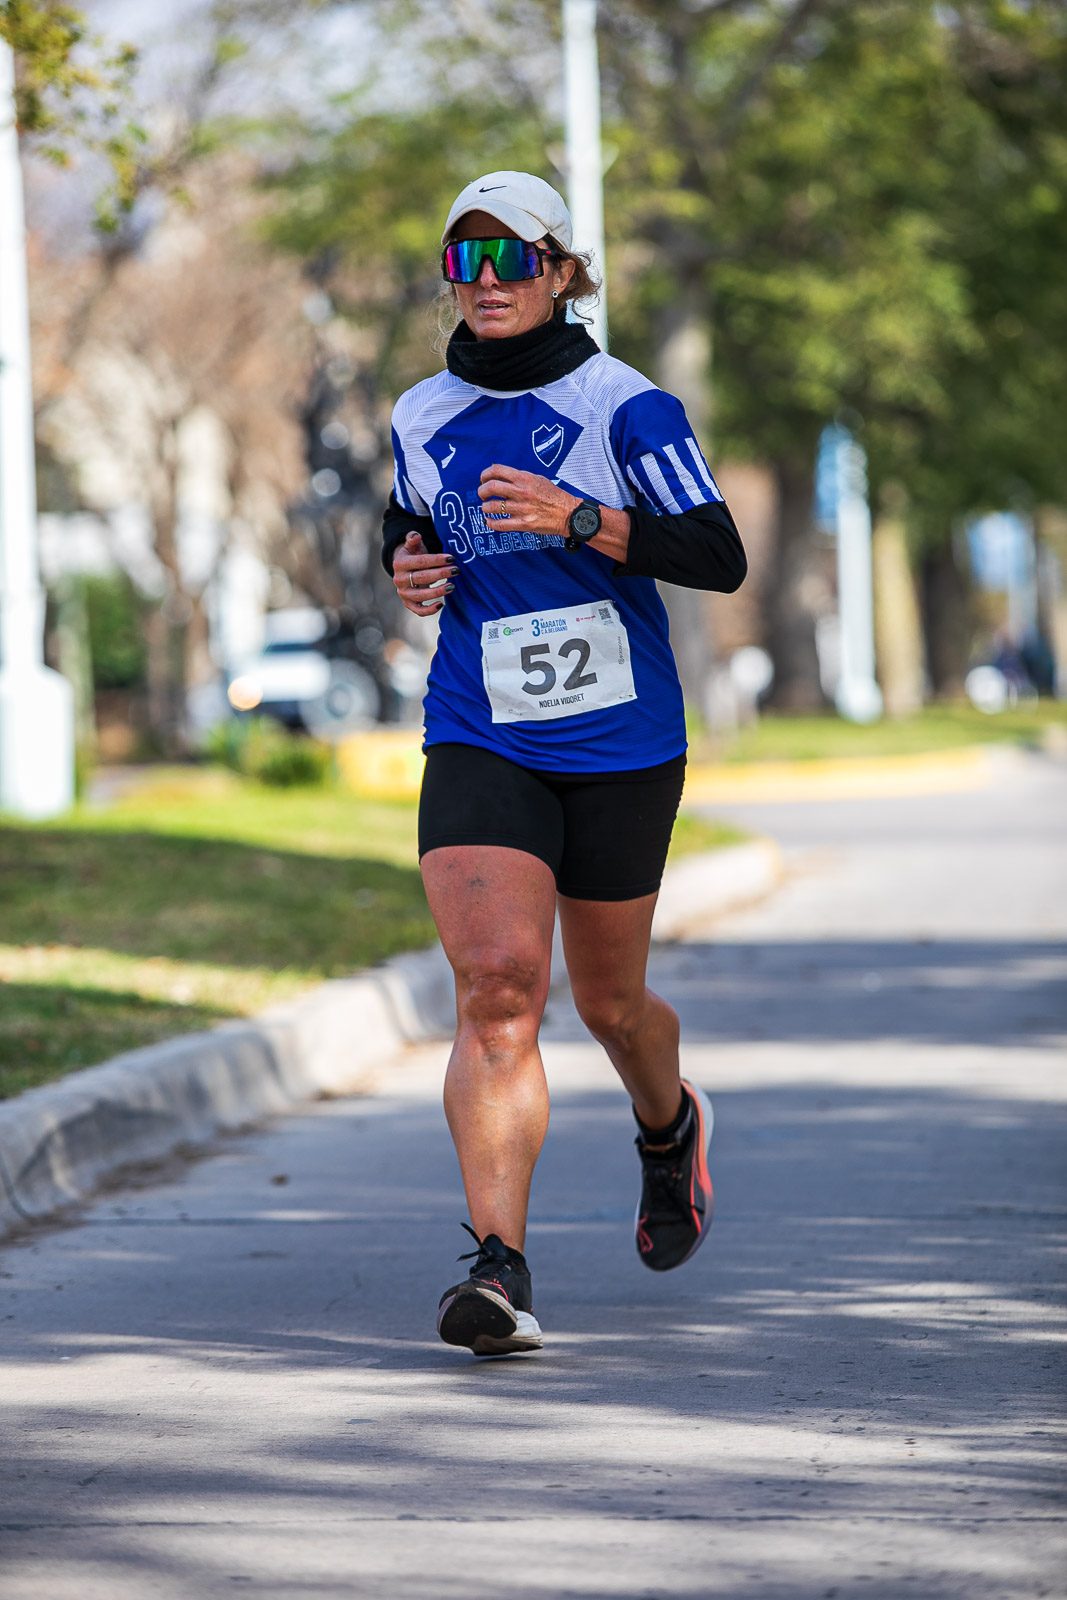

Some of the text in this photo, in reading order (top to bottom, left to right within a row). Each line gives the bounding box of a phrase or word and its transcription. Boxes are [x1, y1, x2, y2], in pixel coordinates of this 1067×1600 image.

[440, 491, 476, 564] 3
[474, 531, 567, 557] C.A.BELGRAN
[531, 619, 541, 637] 3
[540, 618, 567, 629] MARATÓN
[520, 638, 598, 696] 52
[538, 698, 561, 709] NOELIA
